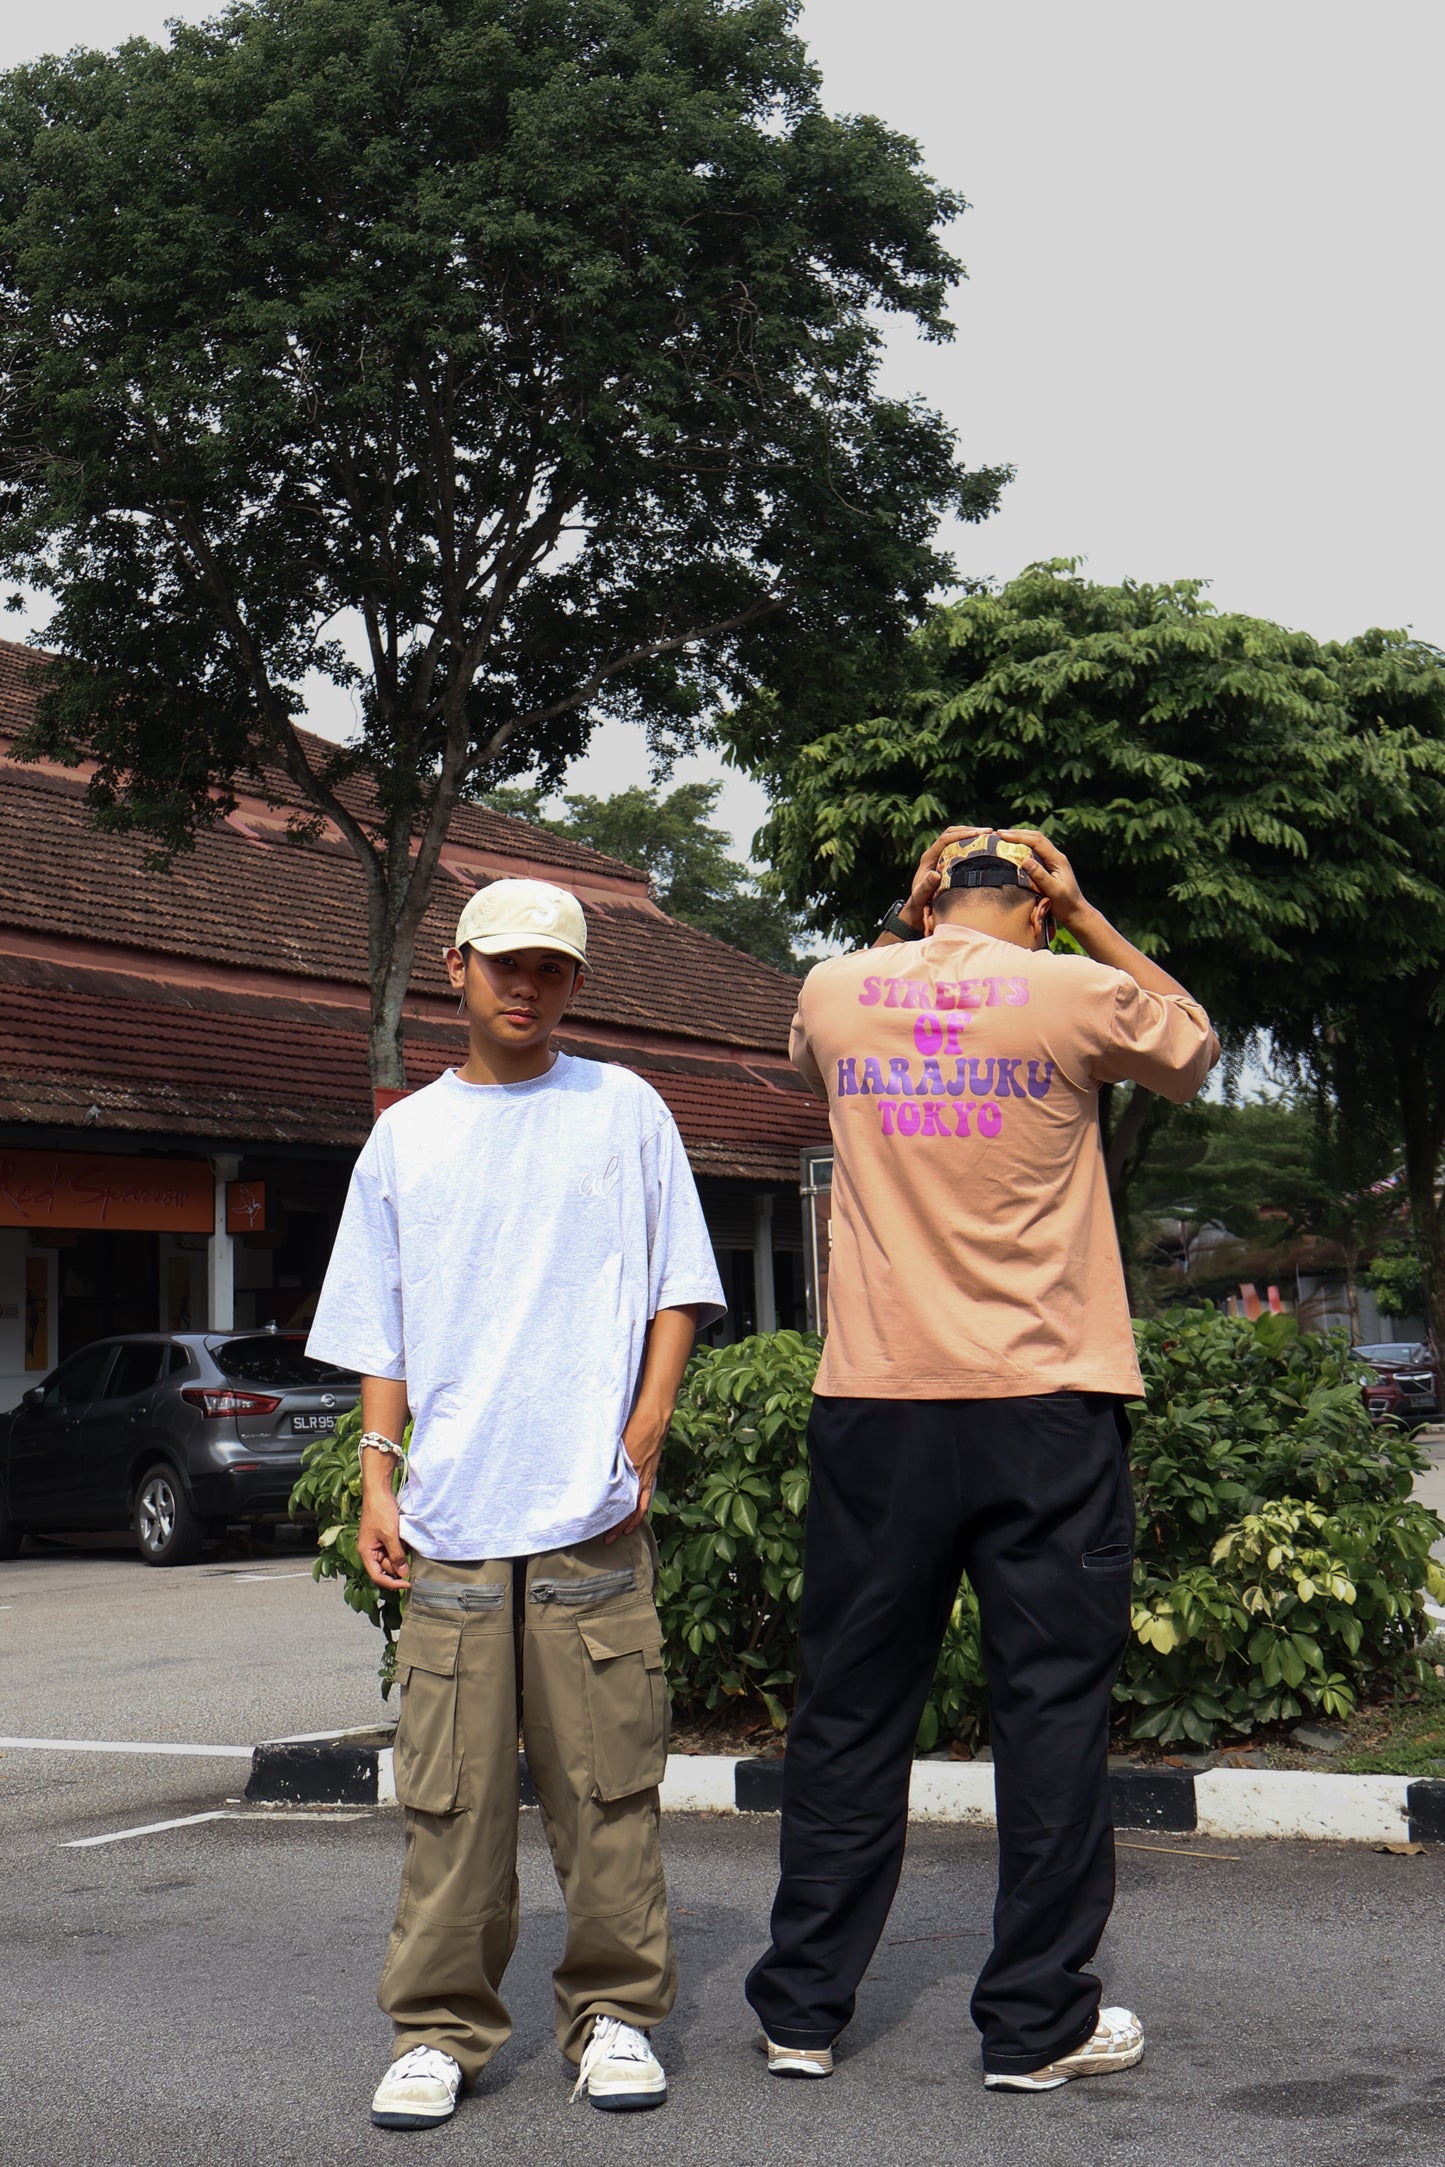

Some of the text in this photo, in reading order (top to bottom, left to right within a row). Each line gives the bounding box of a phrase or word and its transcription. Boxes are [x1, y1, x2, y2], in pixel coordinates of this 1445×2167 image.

[858, 976, 1030, 1011] STREETS
[914, 1012, 972, 1056] OF
[837, 1057, 1055, 1099] HARAJUKU
[877, 1101, 1002, 1138] TOKYO
